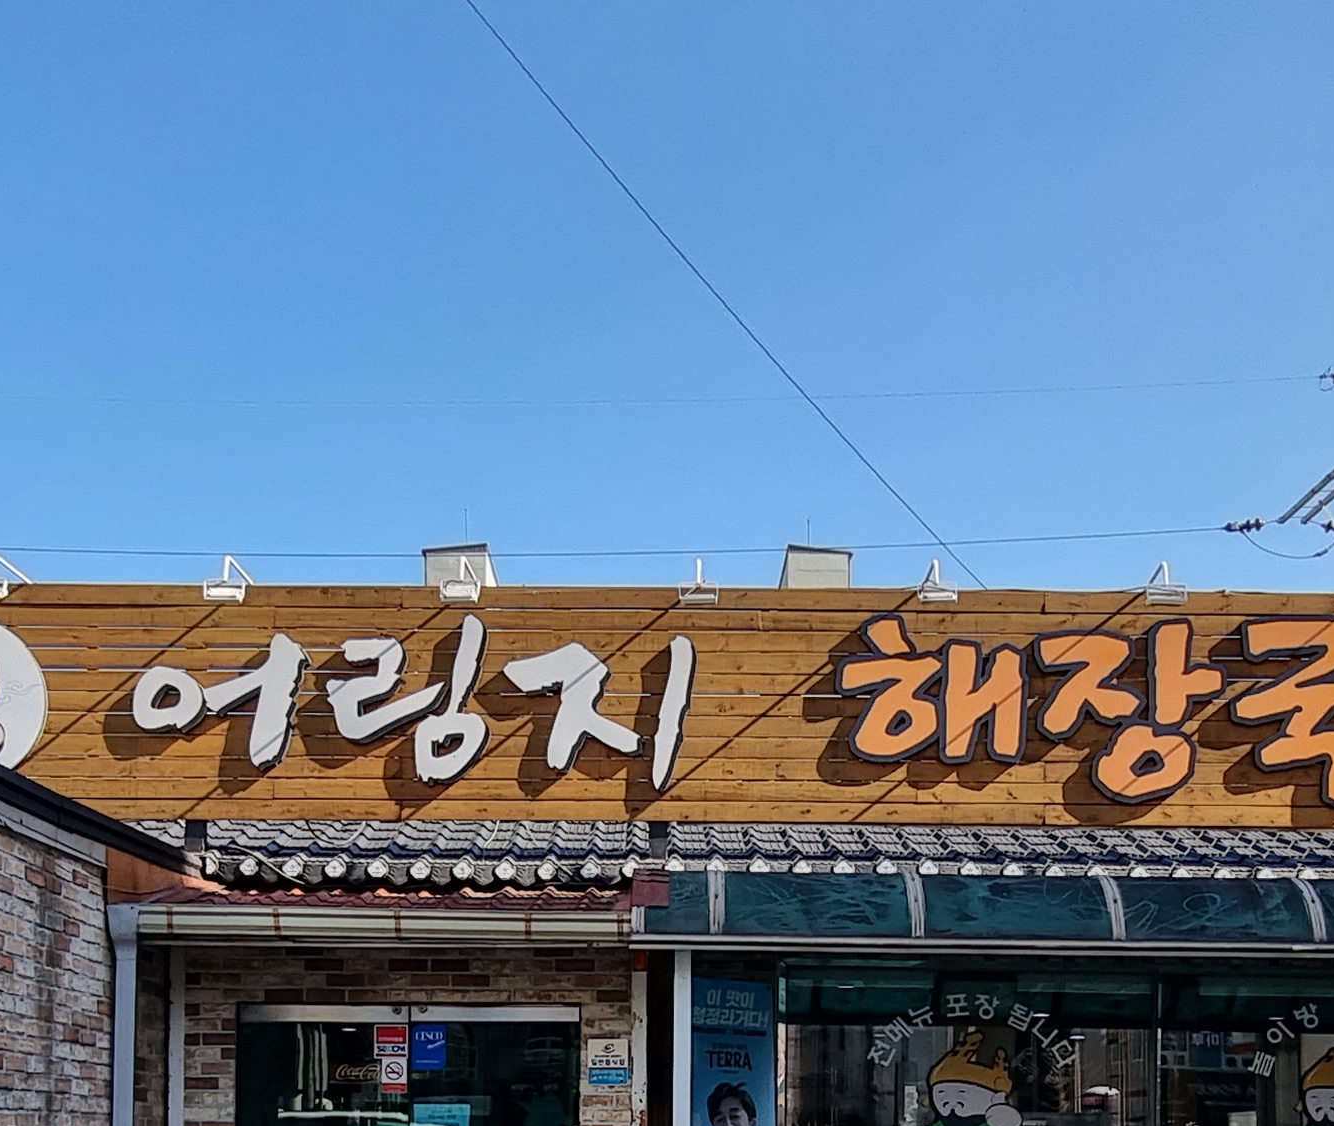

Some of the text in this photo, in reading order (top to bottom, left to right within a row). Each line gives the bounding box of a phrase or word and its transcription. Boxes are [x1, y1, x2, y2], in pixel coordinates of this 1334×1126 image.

[133, 614, 696, 790] 어링지
[707, 988, 756, 1009] 이 맛이
[946, 993, 1000, 1020] 포장
[415, 1030, 444, 1041] CESCO
[705, 1049, 753, 1072] TERRA
